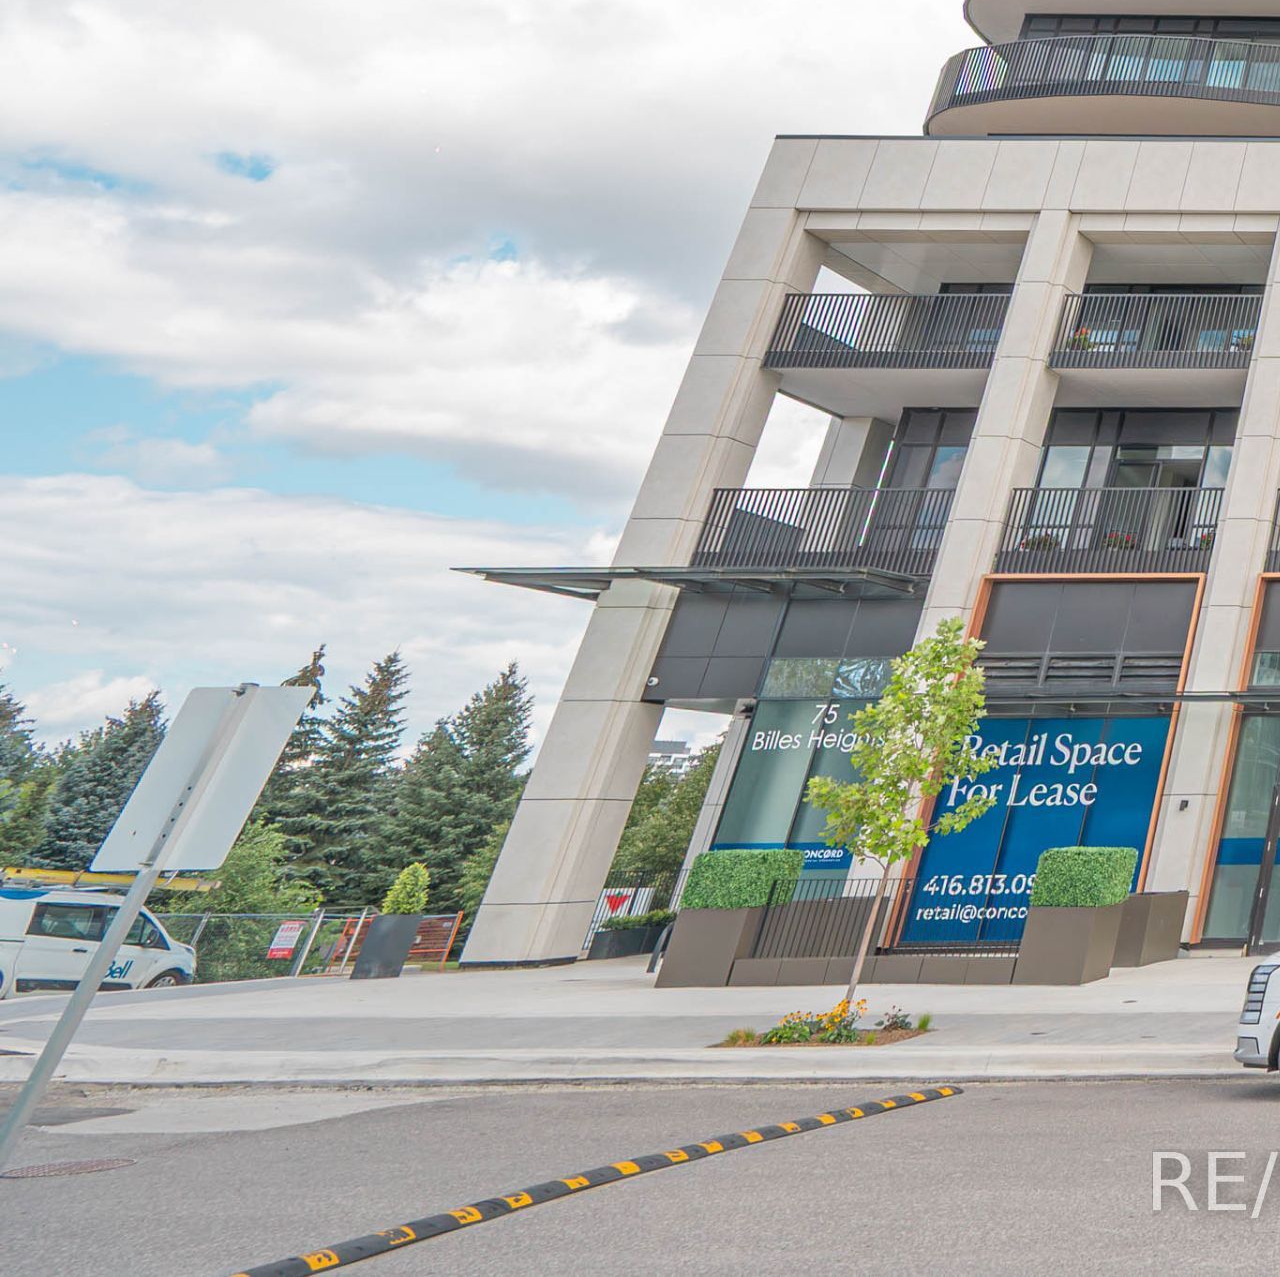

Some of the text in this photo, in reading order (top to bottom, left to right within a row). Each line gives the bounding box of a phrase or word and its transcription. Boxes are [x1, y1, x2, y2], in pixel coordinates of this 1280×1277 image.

[811, 704, 840, 724] 75
[751, 728, 885, 753] Billes Heigs
[959, 732, 1142, 774] Retail Space
[947, 773, 1098, 807] For Lease
[915, 904, 1029, 924] retail@conco
